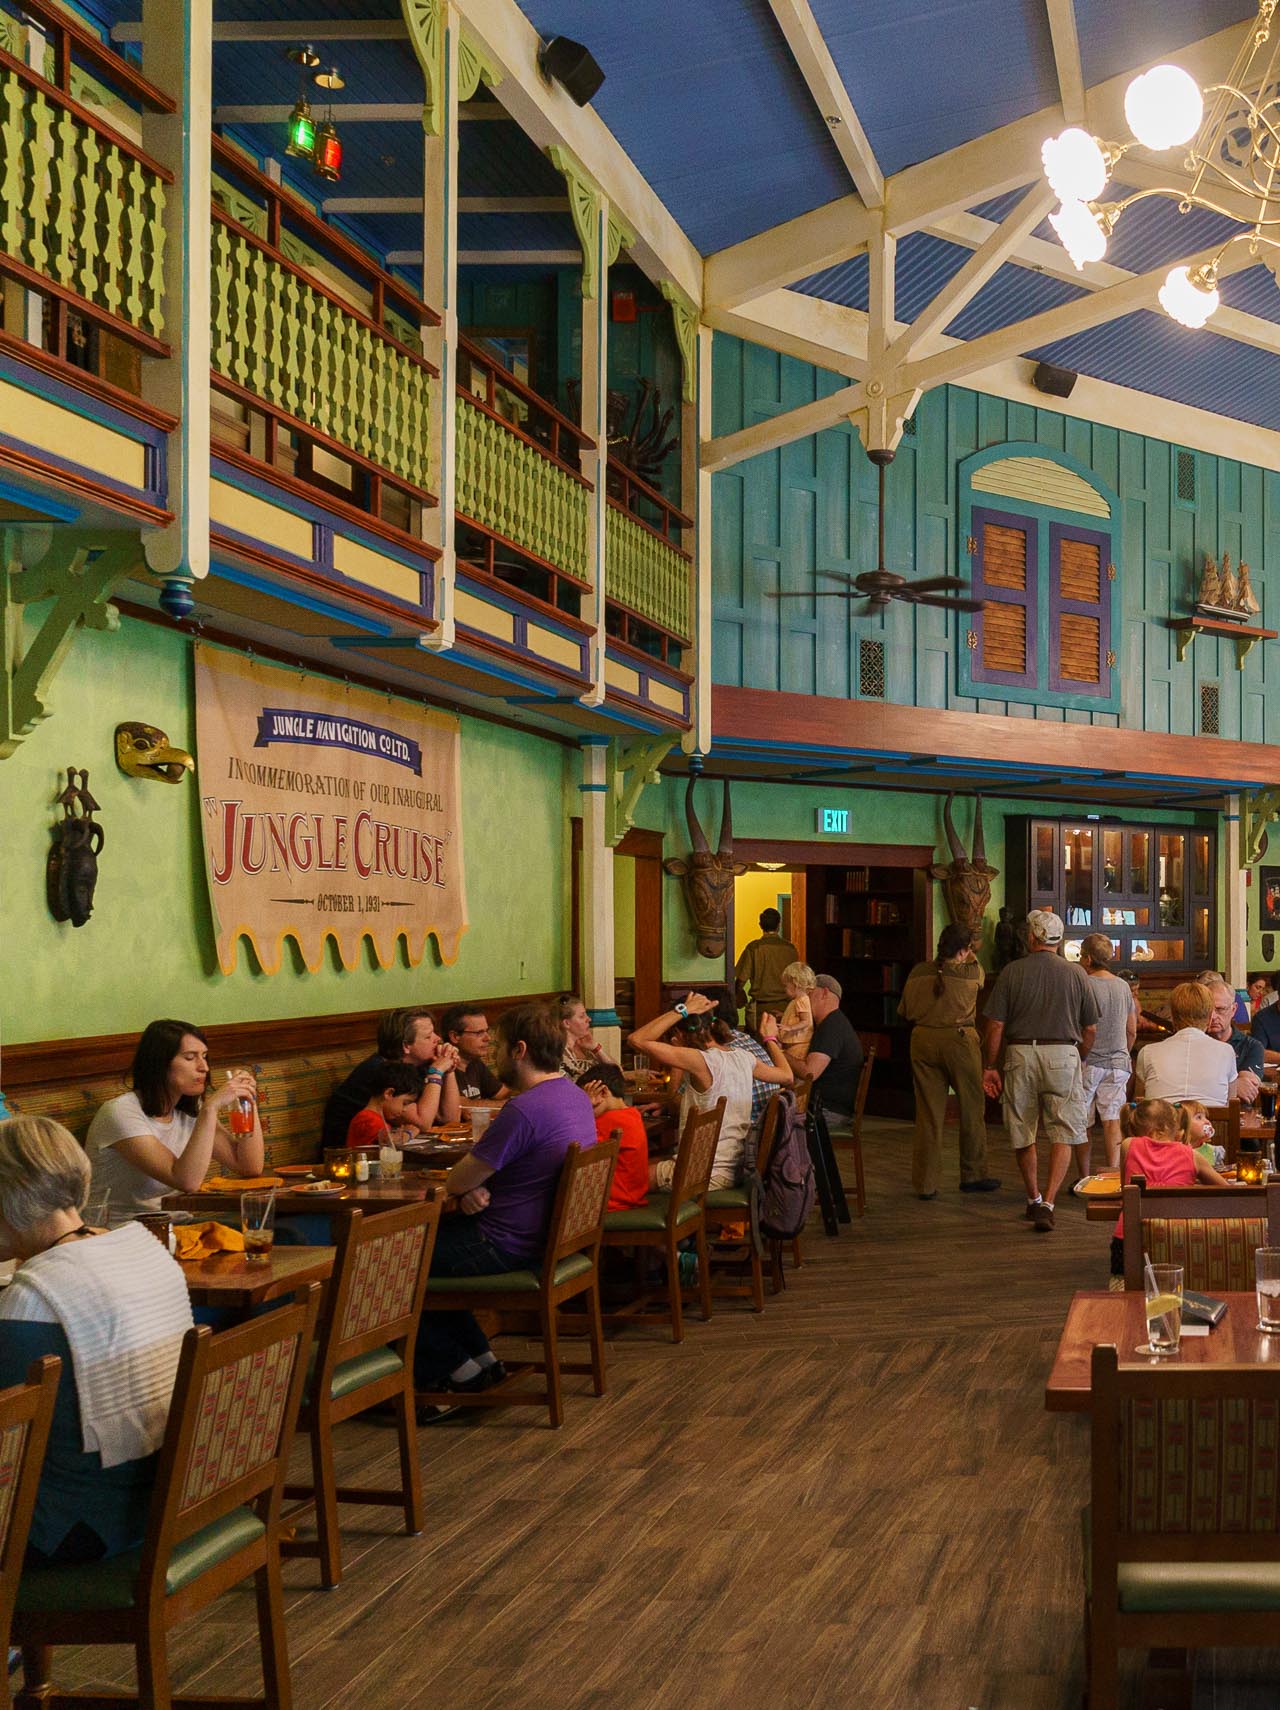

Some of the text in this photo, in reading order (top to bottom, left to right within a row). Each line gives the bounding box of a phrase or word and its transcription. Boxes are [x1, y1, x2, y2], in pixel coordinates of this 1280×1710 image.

[273, 715, 314, 738] JUNGLE
[316, 720, 376, 750] NAVIGATION
[243, 761, 350, 798] COMMEMORATION
[353, 780, 366, 801] OF
[370, 783, 390, 806] OUR
[392, 786, 443, 812] INAUGURAL
[823, 809, 849, 833] EXIT
[317, 893, 355, 912] OCTOBER
